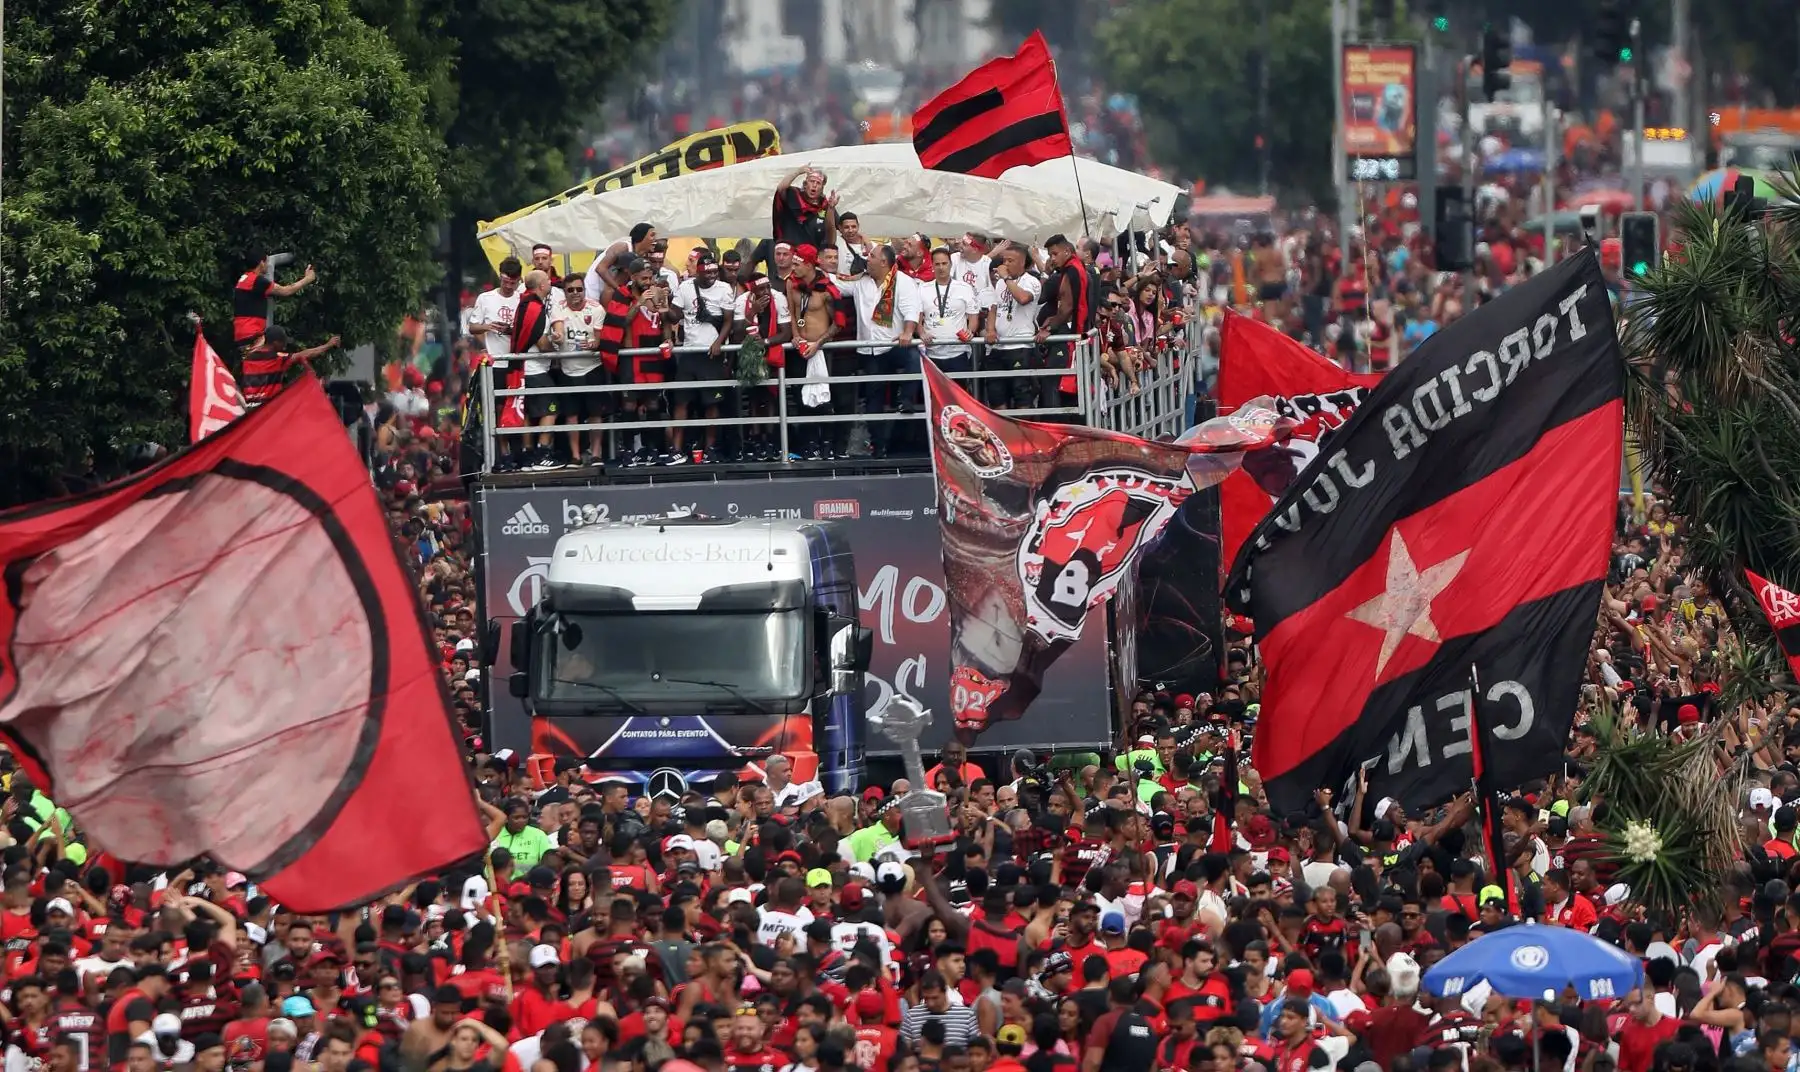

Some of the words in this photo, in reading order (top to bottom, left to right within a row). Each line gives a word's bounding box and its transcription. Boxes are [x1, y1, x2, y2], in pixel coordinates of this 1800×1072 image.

[778, 508, 801, 520] TIM
[819, 502, 854, 514] BRAHMA
[923, 507, 939, 515] Ber
[502, 522, 549, 535] adidas
[581, 542, 765, 563] Mercedes-Benz
[622, 730, 657, 738] CONTATOS
[658, 730, 676, 738] PARA
